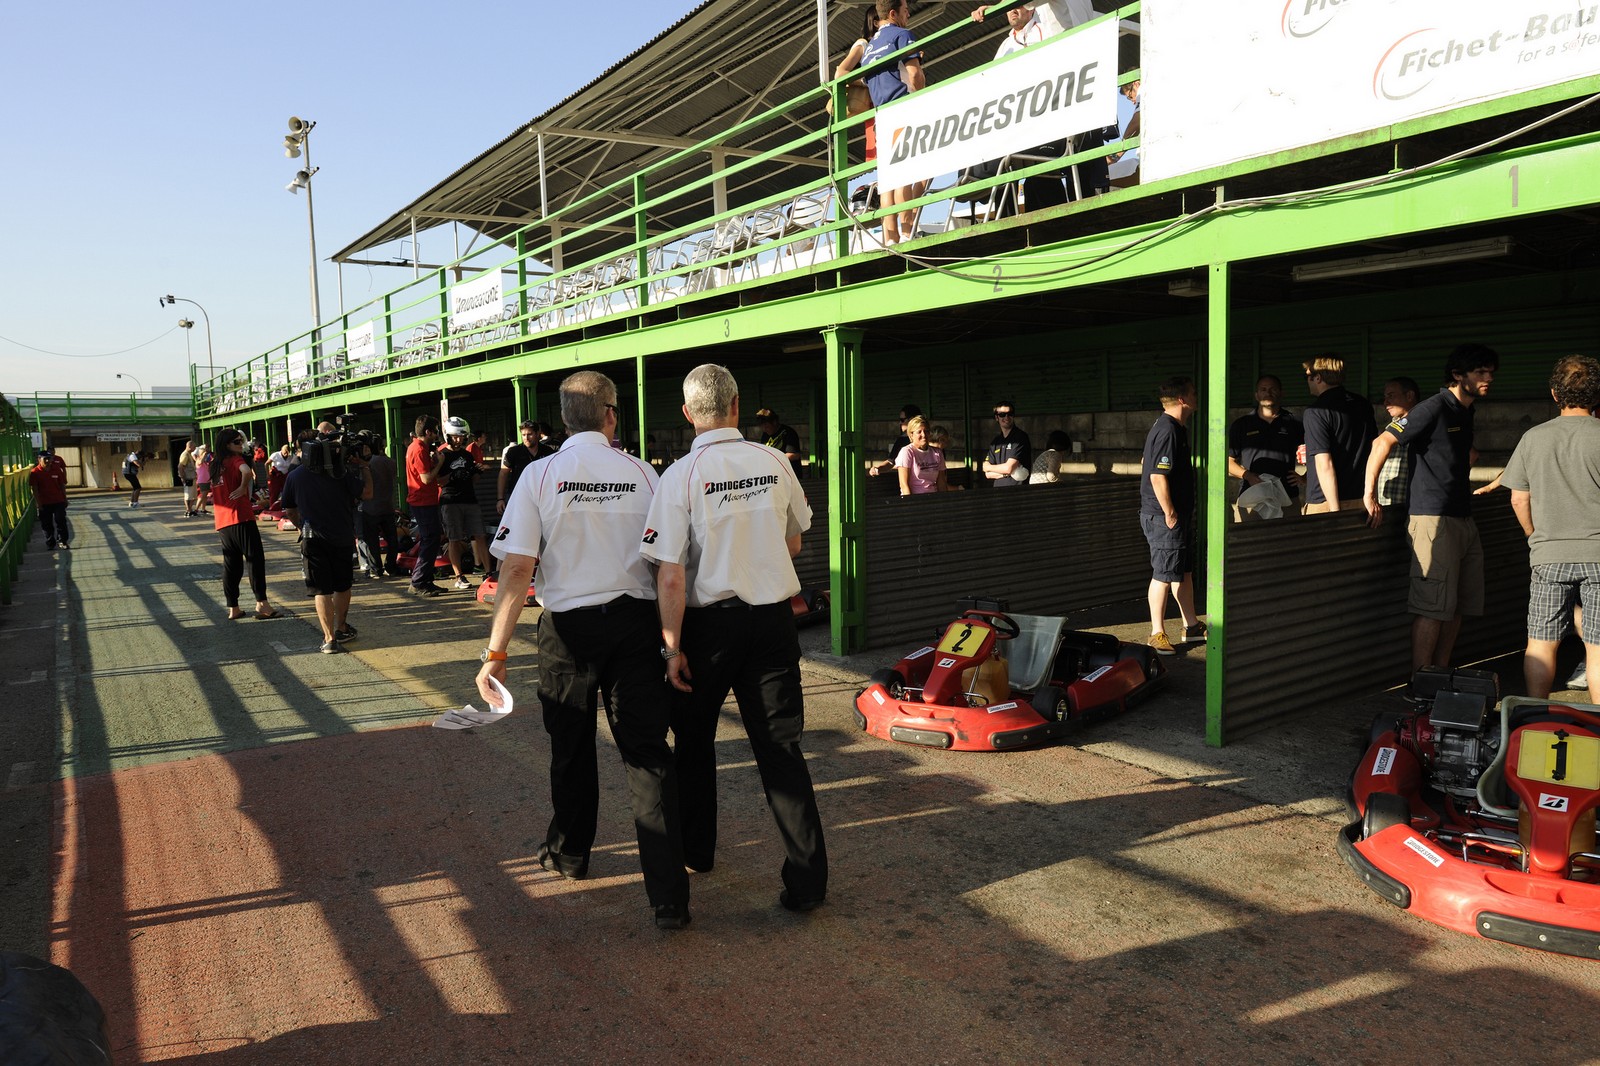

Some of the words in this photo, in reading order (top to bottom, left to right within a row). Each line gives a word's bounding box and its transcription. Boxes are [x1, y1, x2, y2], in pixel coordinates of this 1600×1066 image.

[1517, 49, 1541, 64] for
[1546, 45, 1556, 56] a
[889, 61, 1099, 165] BRIDGESTONE
[1509, 164, 1519, 208] 1
[993, 264, 1003, 293] 2
[724, 318, 730, 338] 3
[557, 481, 637, 494] BRIDGESTONE
[704, 475, 778, 495] BRIDGESTONE
[566, 493, 627, 508] Motorsport
[718, 486, 773, 508] Motorsport
[952, 629, 973, 653] 2
[1551, 740, 1568, 780] 1
[1406, 839, 1441, 864] BRIDGESTONE
